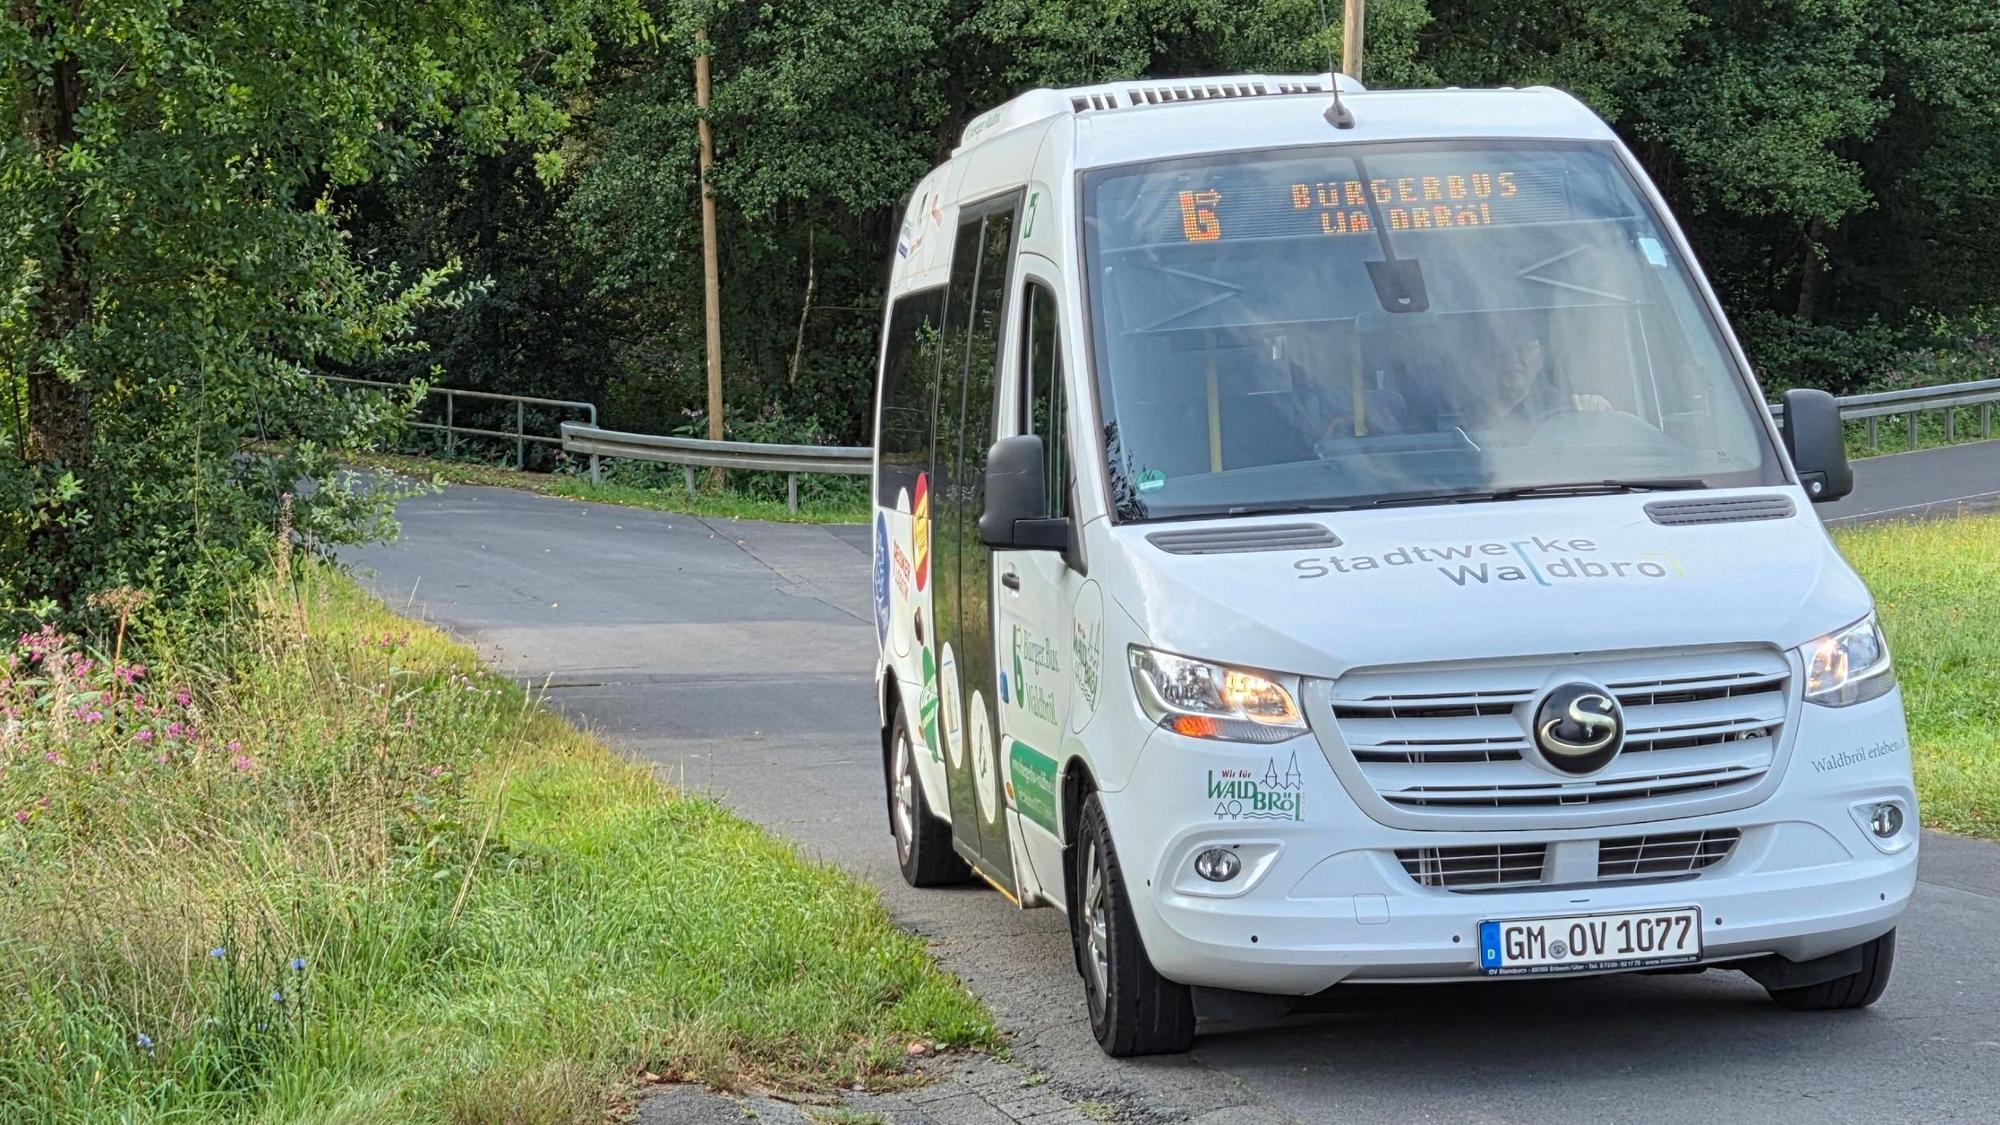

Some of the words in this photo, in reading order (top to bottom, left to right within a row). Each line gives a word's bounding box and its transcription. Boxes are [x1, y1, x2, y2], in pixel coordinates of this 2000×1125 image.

[1292, 536, 1599, 580] Stadtwerke
[1811, 747, 1866, 773] Waldbröl
[1221, 770, 1236, 778] Wir
[1239, 769, 1252, 778] für
[1505, 926, 1546, 960] GM
[1569, 921, 1607, 956] OV
[1616, 915, 1692, 954] 1077
[1487, 949, 1495, 960] D
